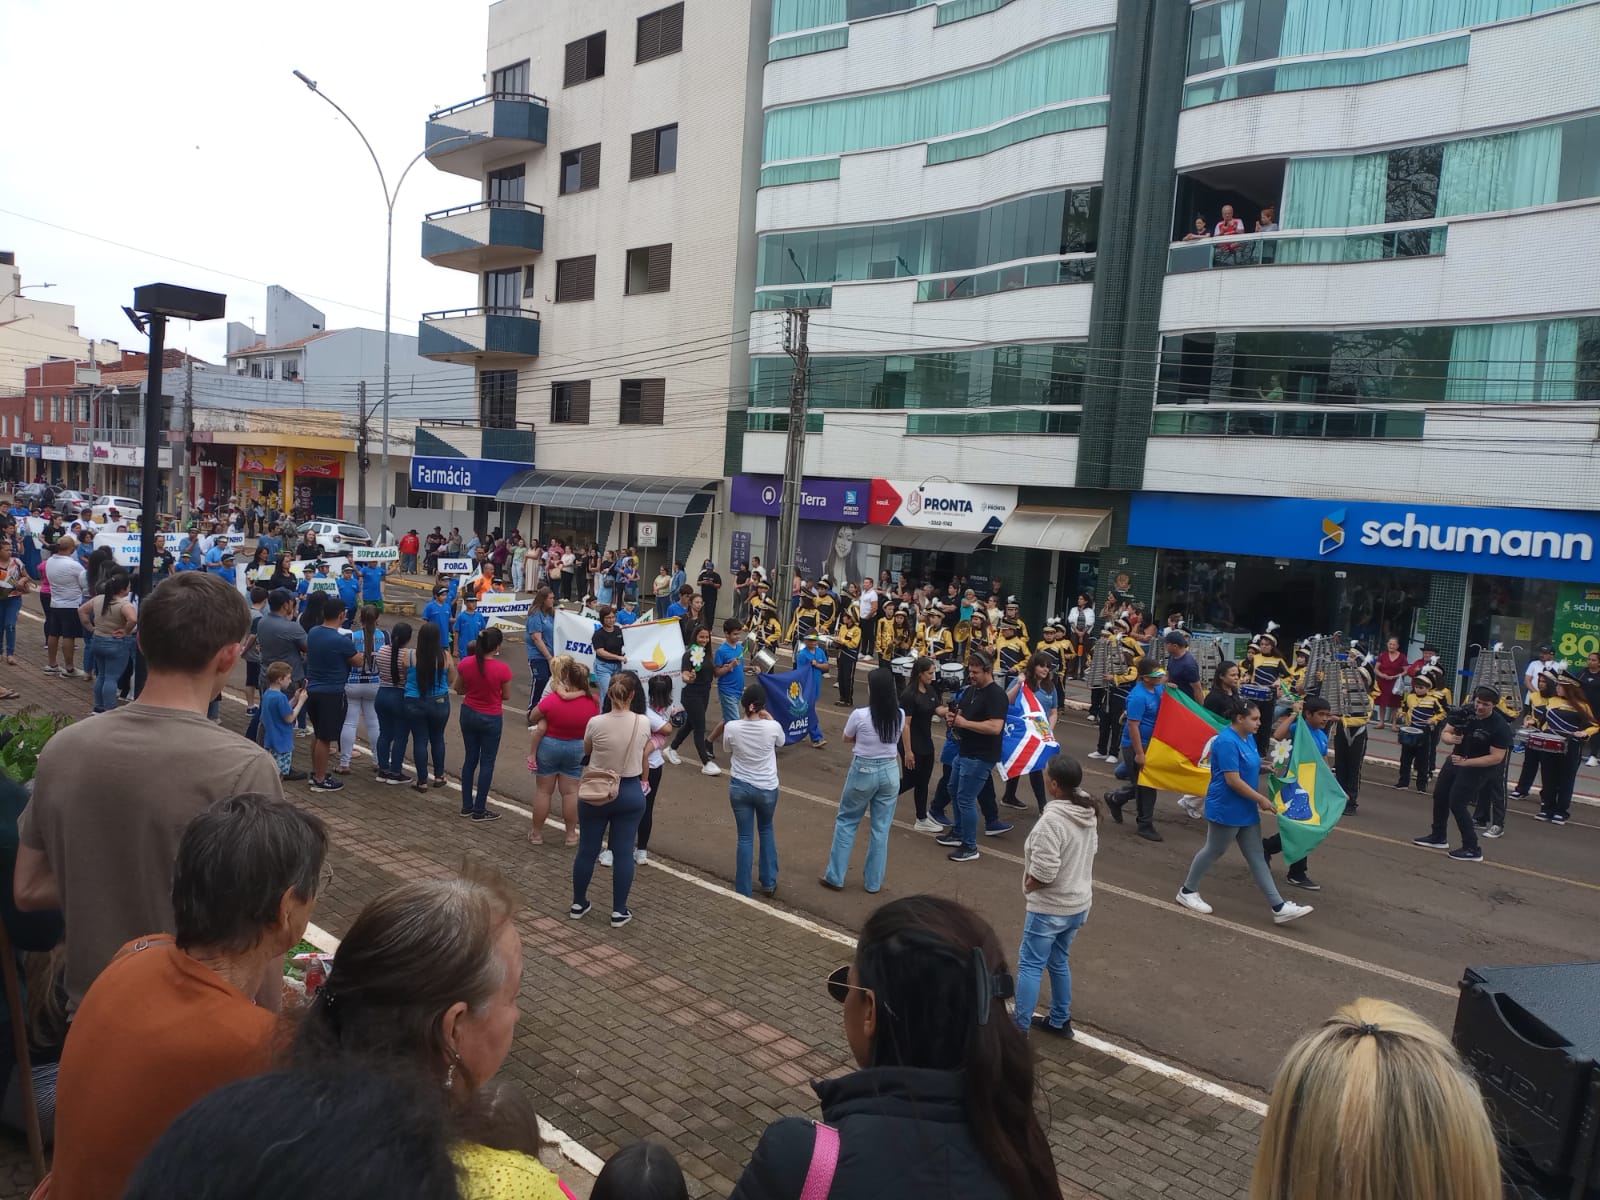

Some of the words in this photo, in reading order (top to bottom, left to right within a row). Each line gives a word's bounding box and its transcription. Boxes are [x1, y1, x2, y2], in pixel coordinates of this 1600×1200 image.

[418, 465, 471, 486] Farmácia
[924, 498, 973, 512] PRONTA
[1360, 512, 1593, 561] schumann
[565, 640, 593, 655] ESTÁ
[1558, 632, 1600, 658] 80
[789, 717, 809, 730] APAE
